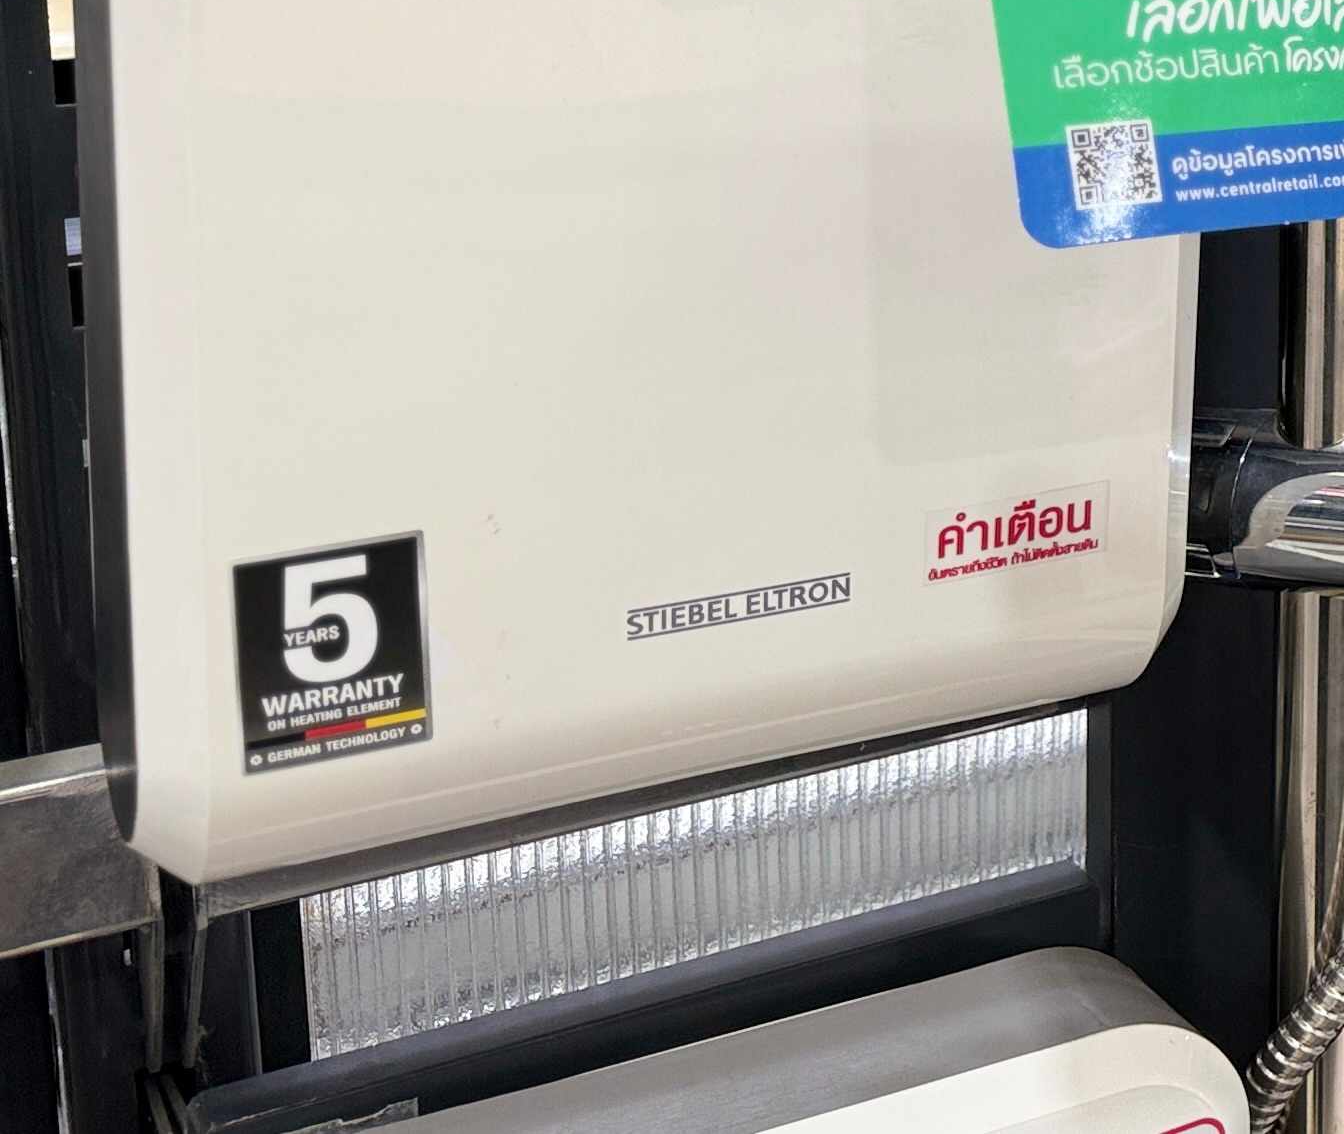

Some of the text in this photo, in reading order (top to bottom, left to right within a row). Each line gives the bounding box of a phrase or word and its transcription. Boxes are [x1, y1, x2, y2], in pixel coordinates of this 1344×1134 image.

[1053, 46, 1280, 90] เลือกช้อปสินค้า
[939, 498, 1093, 560] คำเตือน
[283, 554, 378, 683] 5
[626, 576, 851, 637] STIEBEL ELTRON
[284, 624, 341, 647] YEARS
[261, 672, 404, 718] WARRANTY
[267, 696, 402, 732] ON HEATING ELEMENT
[267, 726, 406, 764] GERMAN TECHNOLOGY
